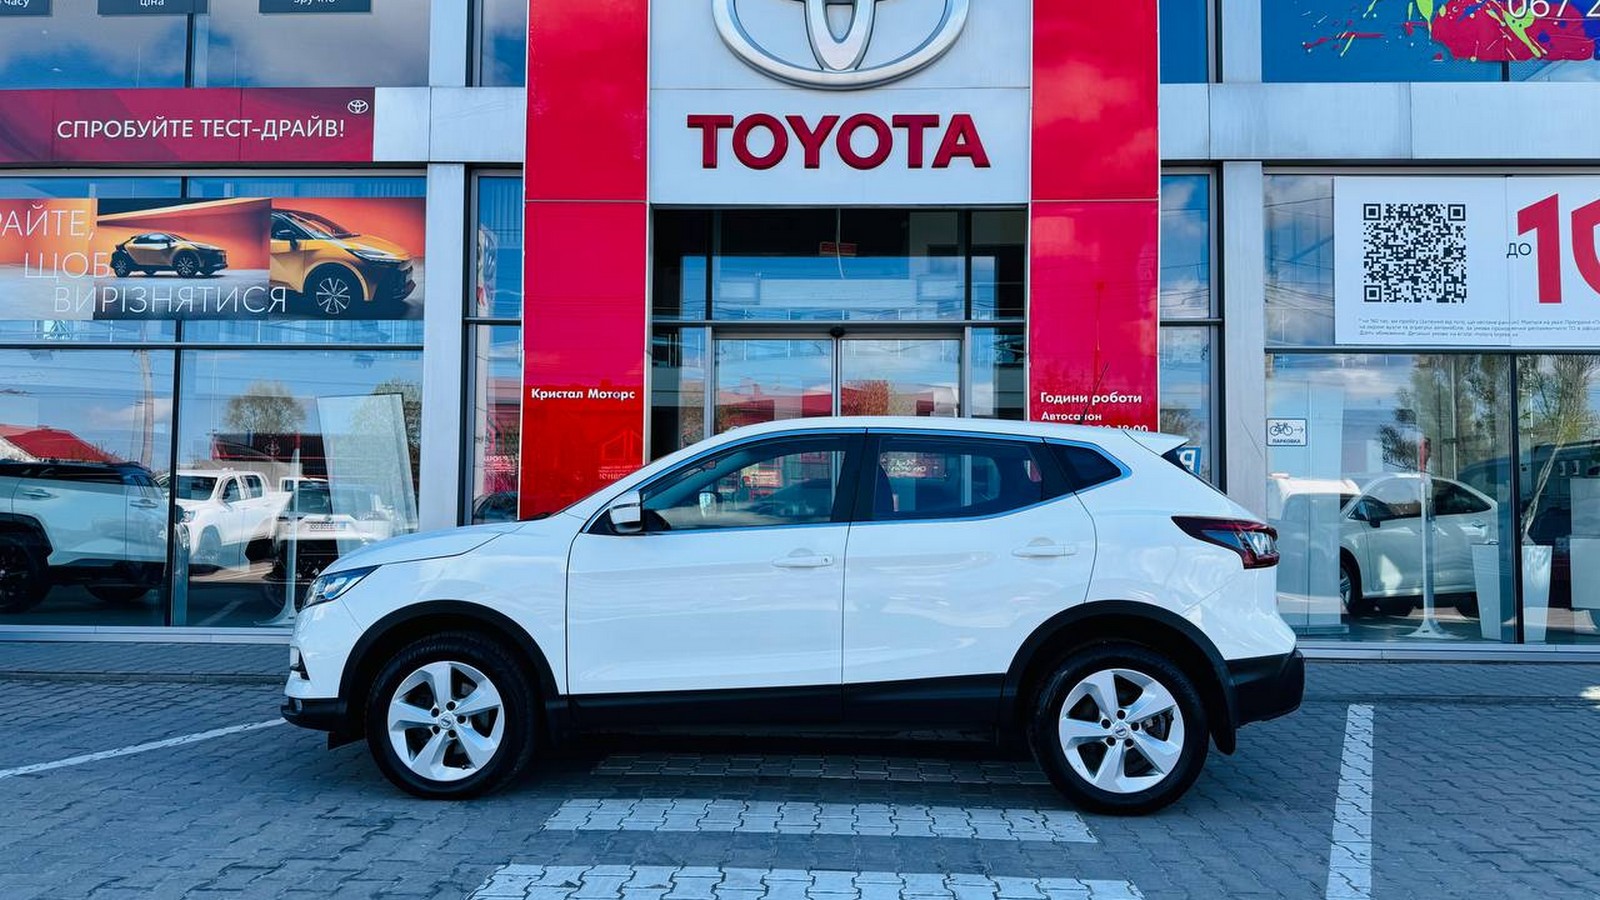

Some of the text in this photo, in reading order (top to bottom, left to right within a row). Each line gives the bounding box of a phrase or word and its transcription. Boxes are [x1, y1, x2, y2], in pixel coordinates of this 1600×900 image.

[56, 115, 346, 141] СПРОБУЙТЕ ТЕСТ-ДРАЙВ!
[687, 113, 991, 170] TOYOTA
[0, 204, 95, 241] АЙТЕ,
[25, 251, 110, 284] ЩОБ
[54, 286, 287, 314] ВИРІЗНЯТИСЯ
[531, 389, 636, 401] Кристал Моторс
[1040, 391, 1142, 405] Години роботи
